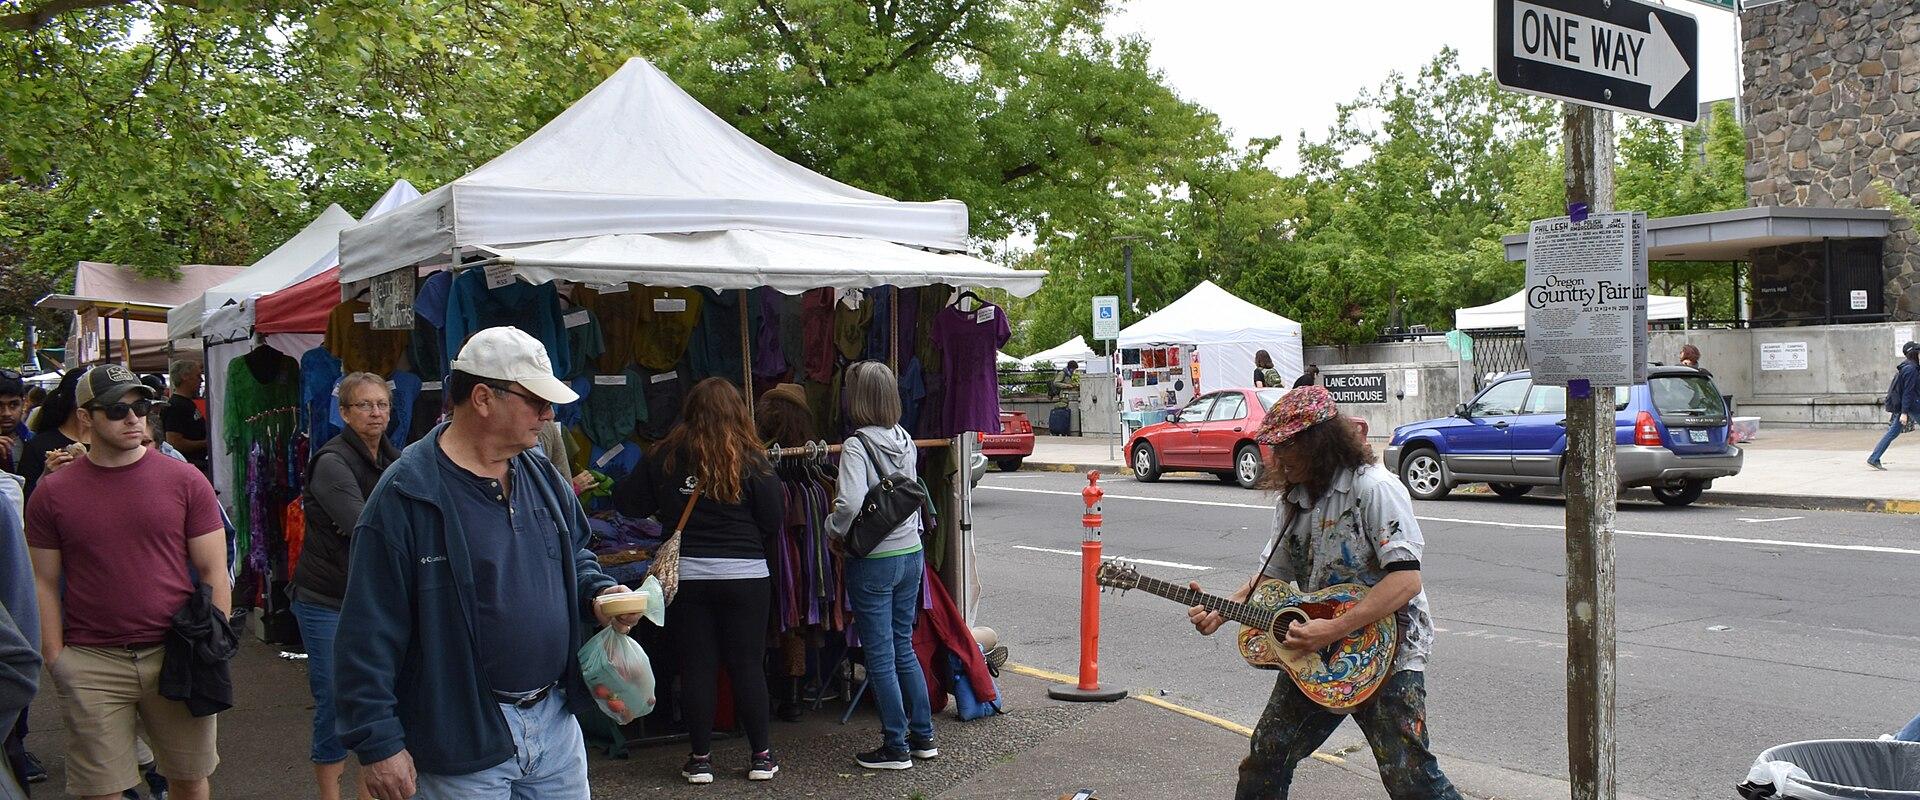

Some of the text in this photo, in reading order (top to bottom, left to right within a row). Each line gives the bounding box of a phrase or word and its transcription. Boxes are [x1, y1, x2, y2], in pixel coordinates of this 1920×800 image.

[1522, 9, 1645, 77] ONE WAY
[1534, 224, 1549, 233] PHIL
[1550, 222, 1569, 231] LESH
[1545, 274, 1585, 289] Oregon
[1527, 280, 1631, 310] Country Fair
[1325, 376, 1382, 387] LANE COUNTY
